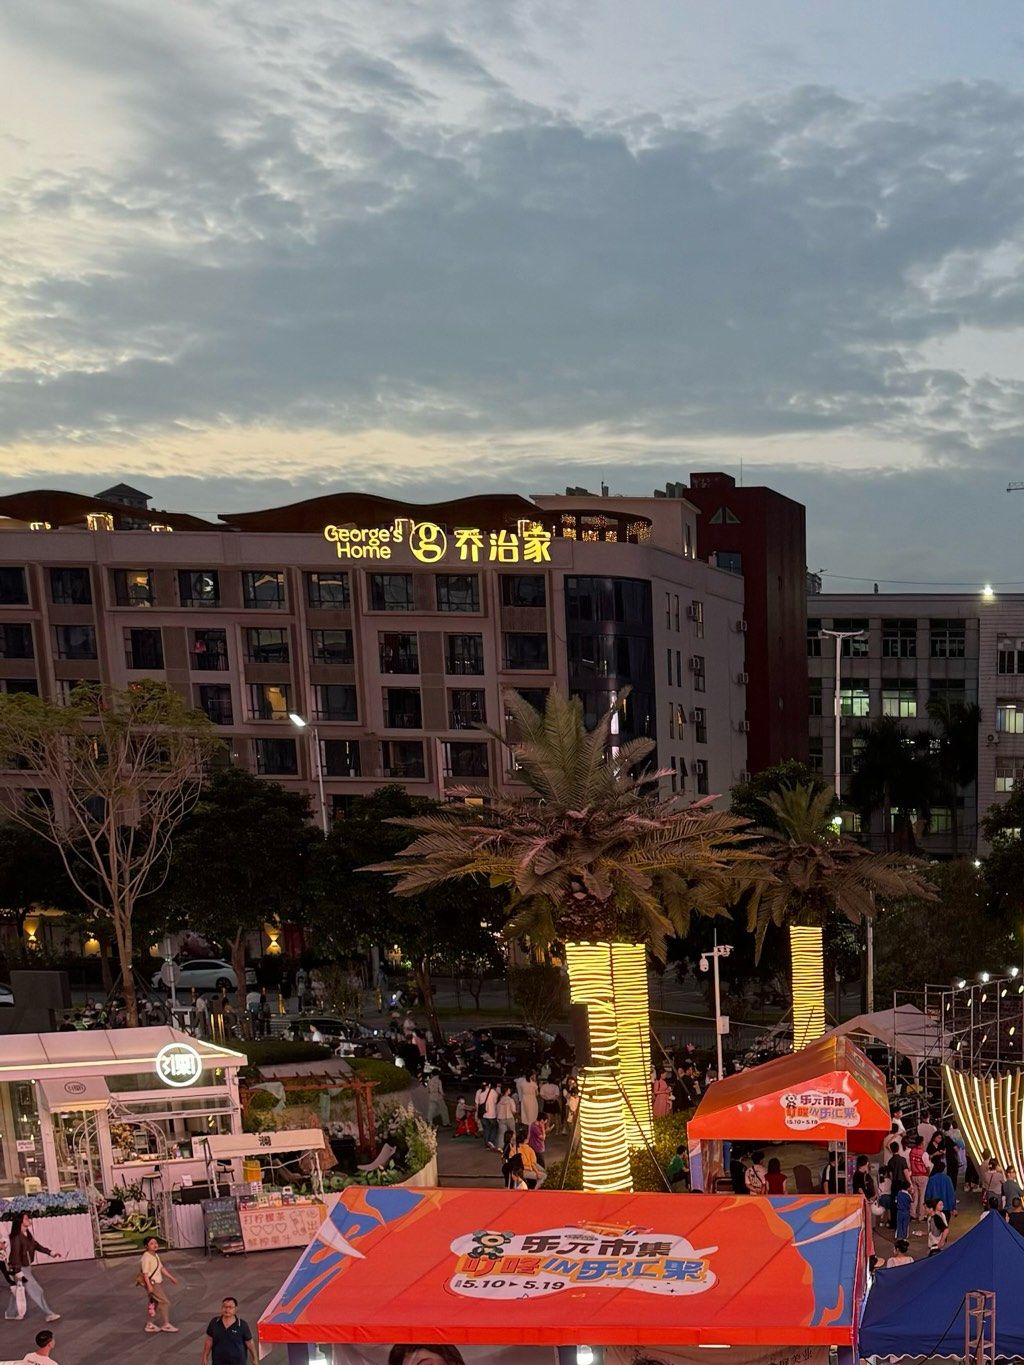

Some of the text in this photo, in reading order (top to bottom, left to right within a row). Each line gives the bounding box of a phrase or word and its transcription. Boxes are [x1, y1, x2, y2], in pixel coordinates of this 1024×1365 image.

[324, 525, 403, 546] George's
[454, 526, 552, 563] 乔治家
[337, 542, 391, 559] Home
[463, 1279, 506, 1289] 5.10
[523, 1280, 565, 1290] 5.19
